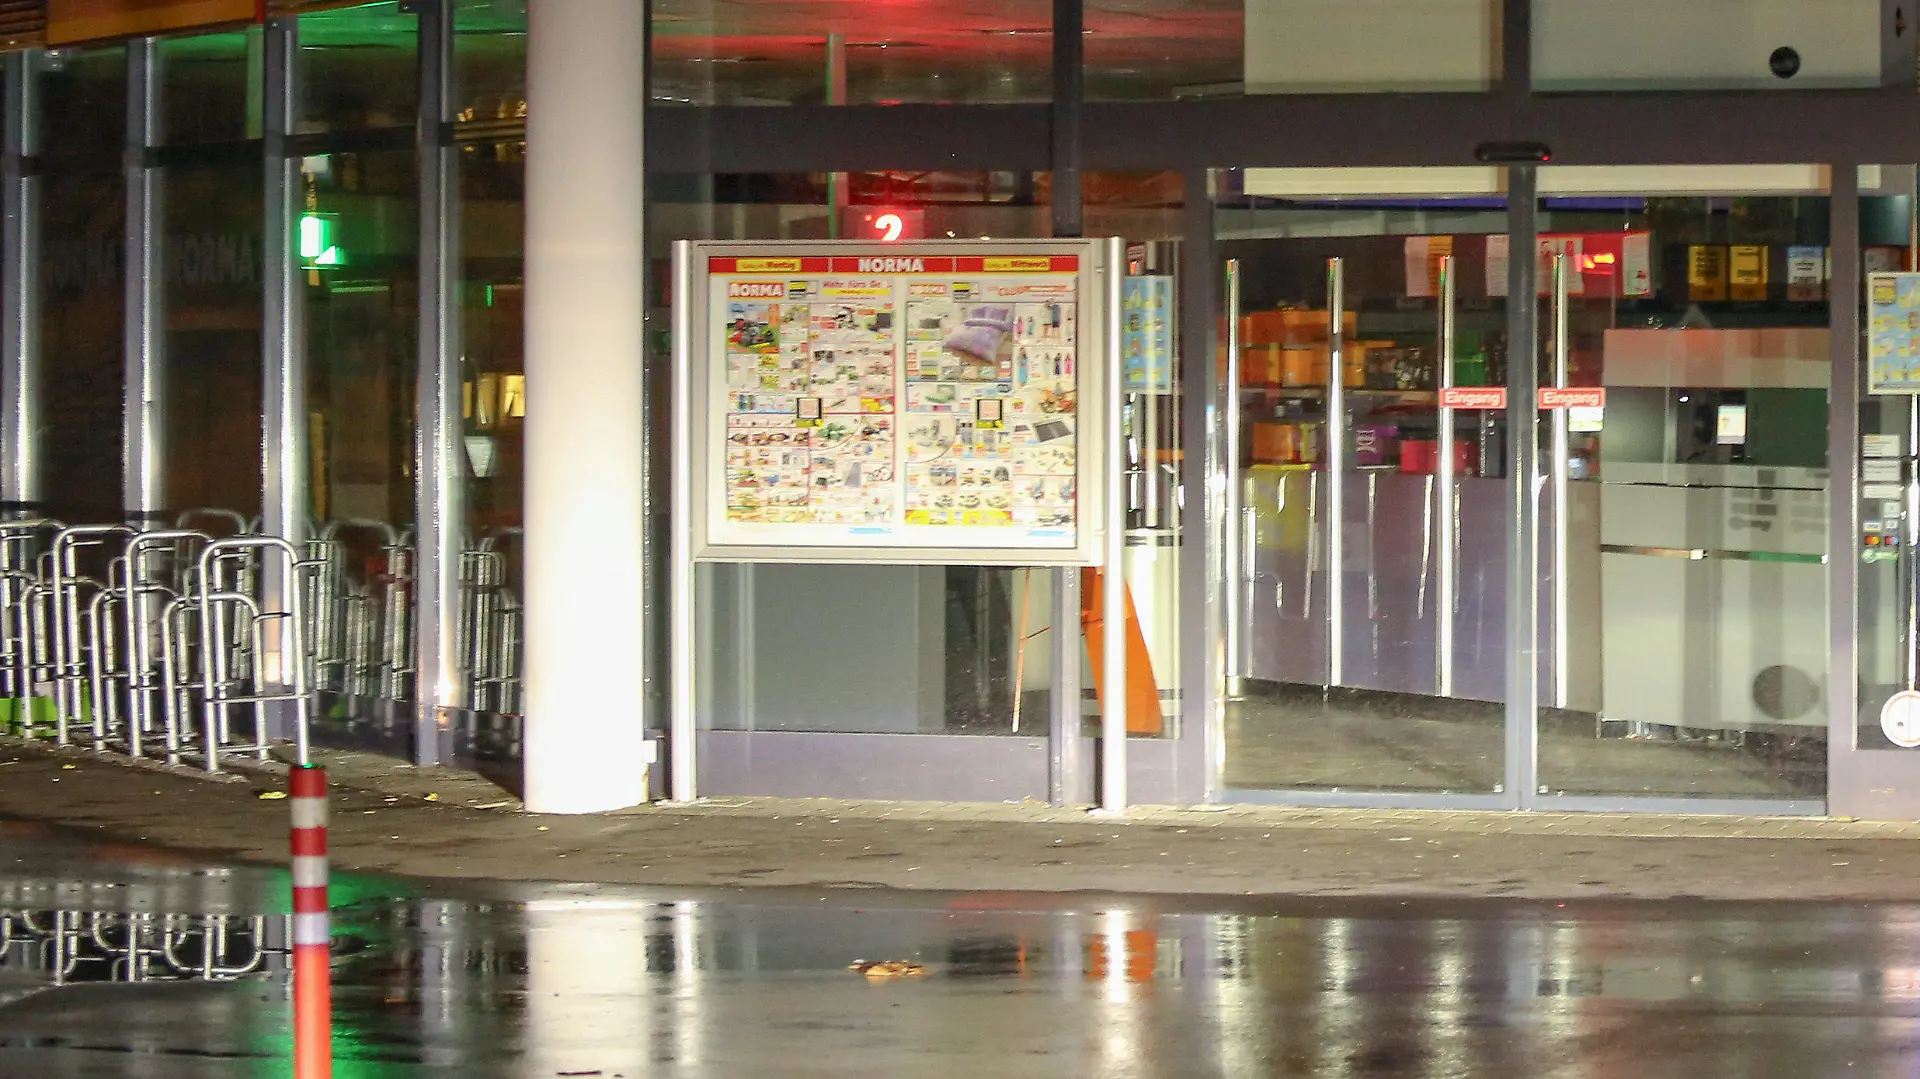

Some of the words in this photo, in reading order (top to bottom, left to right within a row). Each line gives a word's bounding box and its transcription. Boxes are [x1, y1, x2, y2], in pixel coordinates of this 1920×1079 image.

[857, 257, 925, 273] NORMA
[729, 283, 782, 297] NORMA
[1445, 391, 1501, 406] Eingang
[1543, 391, 1600, 406] Eingang
